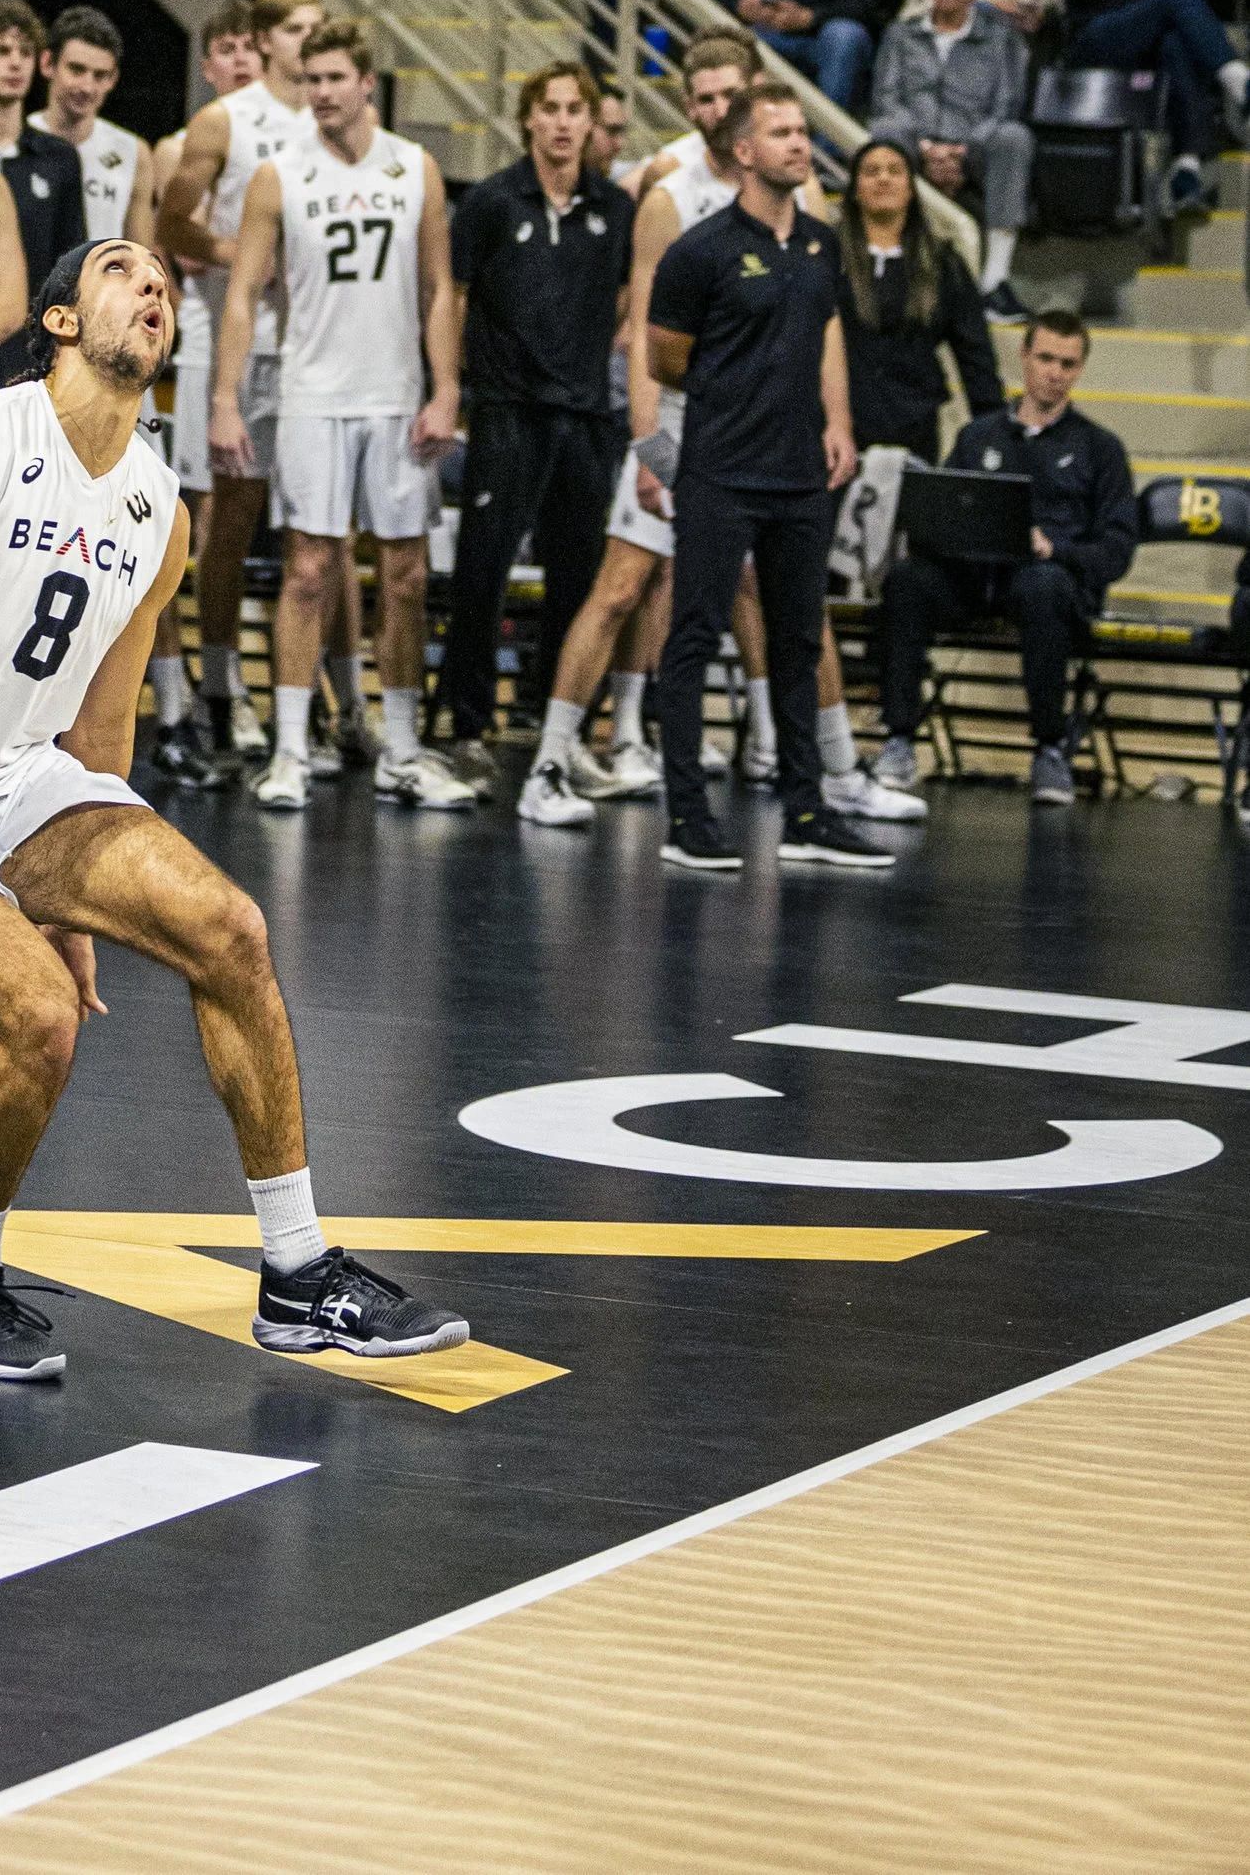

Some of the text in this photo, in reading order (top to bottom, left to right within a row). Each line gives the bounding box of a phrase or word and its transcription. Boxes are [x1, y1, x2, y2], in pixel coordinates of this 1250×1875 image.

[306, 191, 407, 220] BEACH
[324, 217, 394, 284] 27
[7, 517, 138, 587] BEACH
[11, 569, 91, 683] 8
